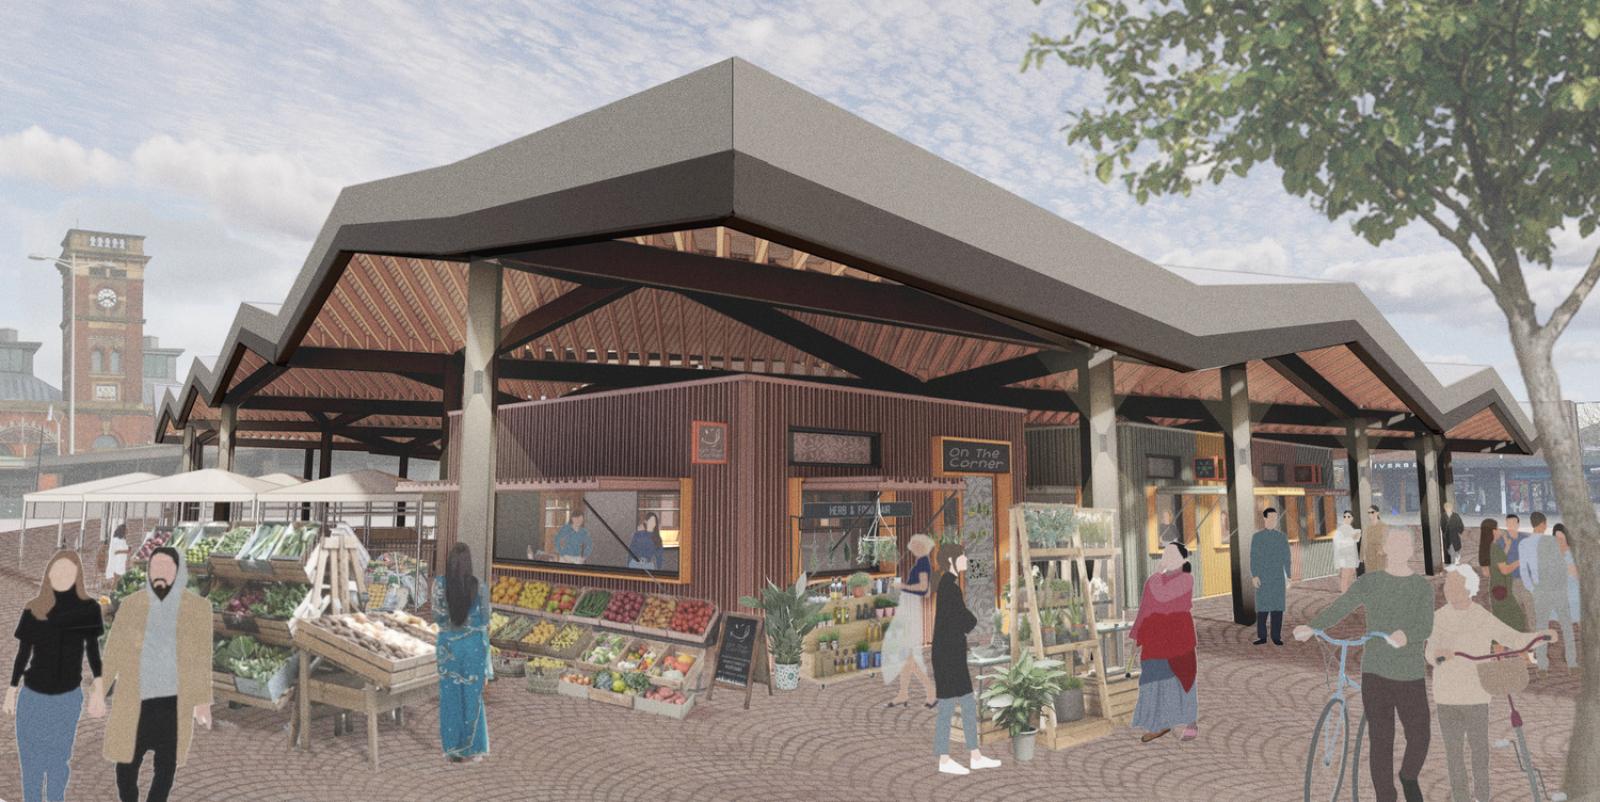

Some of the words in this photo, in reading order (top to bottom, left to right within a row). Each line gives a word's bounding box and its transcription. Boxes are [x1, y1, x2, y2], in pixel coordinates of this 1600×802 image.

[949, 448, 970, 457] On
[976, 448, 1000, 459] The
[949, 457, 1004, 469] Corner
